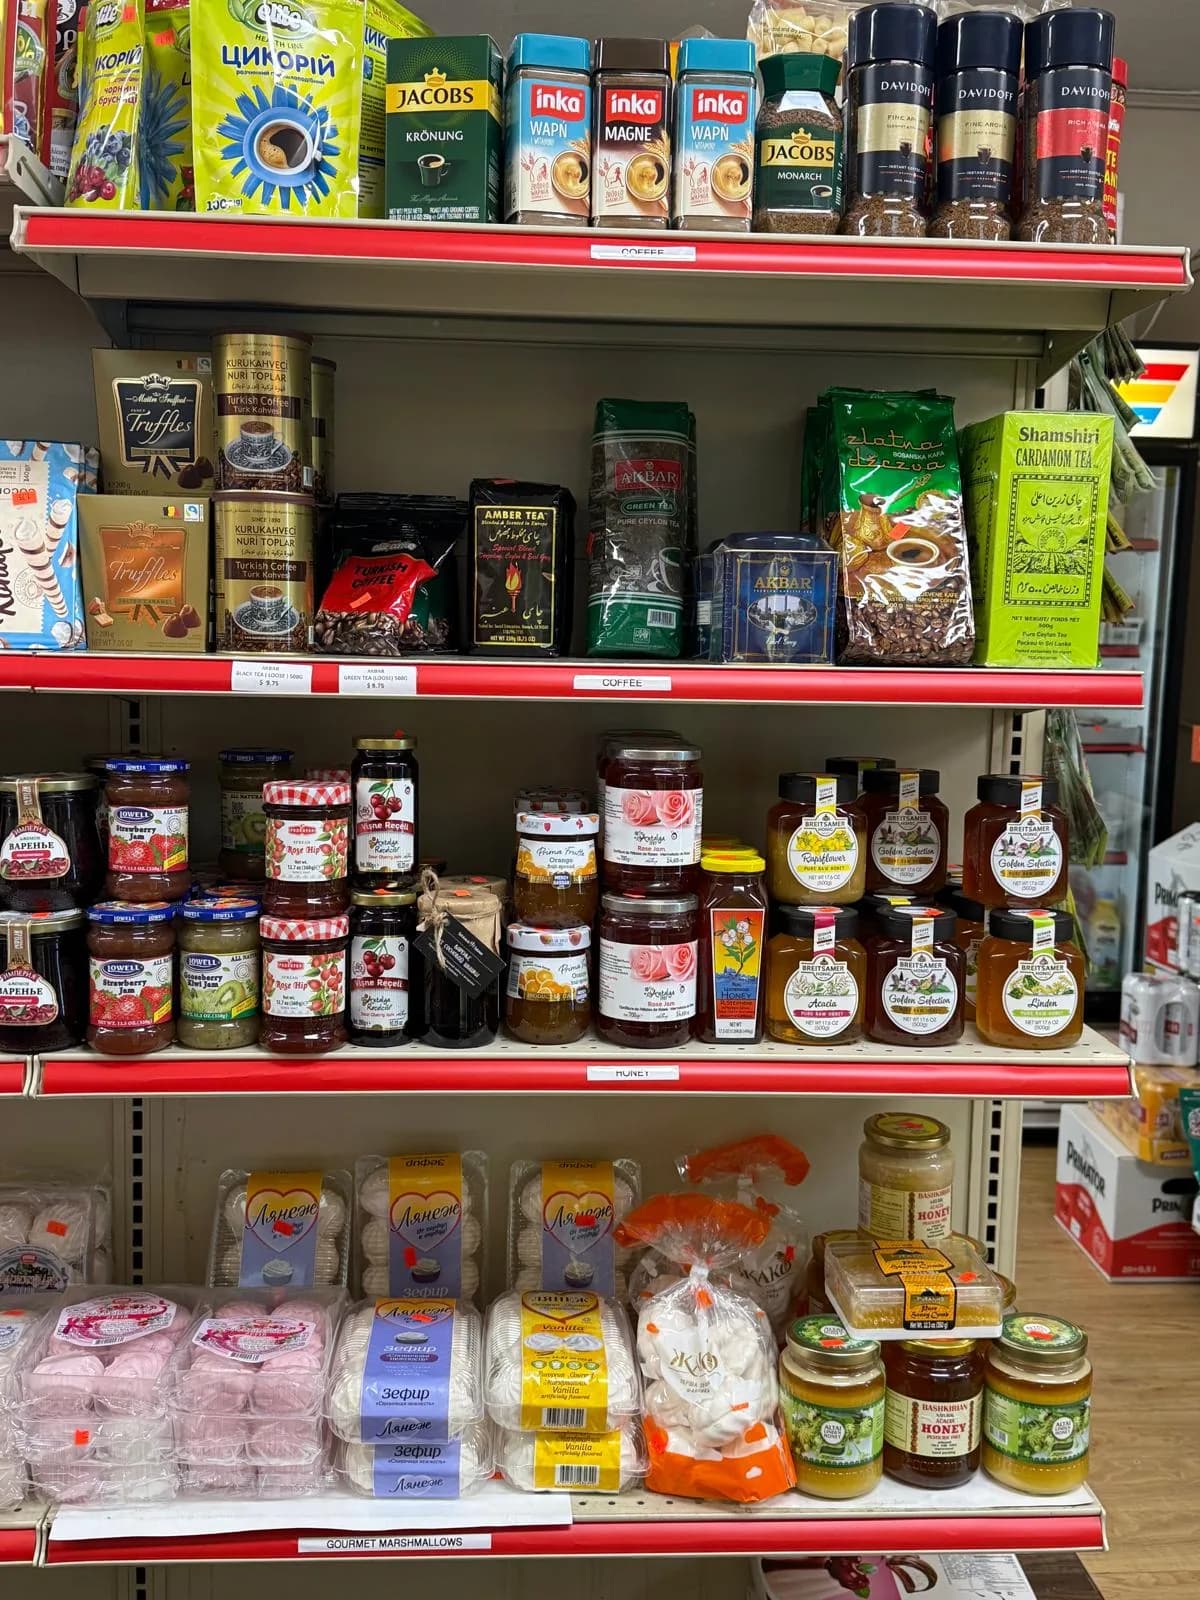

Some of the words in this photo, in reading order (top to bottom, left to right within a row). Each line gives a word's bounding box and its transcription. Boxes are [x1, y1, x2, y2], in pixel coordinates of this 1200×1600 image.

[221, 45, 335, 78] ЦИКОРІЙ
[881, 81, 931, 97] DAVIDOFF
[959, 88, 1014, 101] DAVIDOFF
[1061, 86, 1111, 100] DAVIDOFF
[396, 87, 474, 109] JACOBS
[536, 88, 580, 113] inka
[611, 93, 656, 115] inka
[698, 93, 742, 115] inka
[530, 120, 567, 138] WAPŃ
[691, 123, 729, 140] WAPŃ
[406, 129, 464, 142] KRÖNUNG
[767, 145, 834, 162] JACOBS
[777, 171, 821, 181] MONARCH
[621, 248, 664, 257] COFFEE
[227, 370, 248, 380] NURİ
[251, 371, 287, 382] TOPLAR
[227, 395, 258, 405] Turkish
[260, 396, 289, 407] Coffee
[126, 409, 192, 444] Truffles
[847, 427, 943, 450] zlatna
[1018, 426, 1100, 444] Shamshiri
[893, 451, 927, 460] BOSANSKA
[1015, 447, 1072, 468] CARDAMOM
[1075, 449, 1092, 468] TEA
[621, 470, 677, 484] AKBAR
[626, 502, 656, 510] GREEN
[485, 510, 521, 520] AMBER
[525, 511, 545, 520] TEA
[638, 518, 668, 526] CEYLON
[668, 520, 680, 528] TEA
[236, 537, 258, 546] NURİ
[260, 537, 295, 547] TOPLAR
[235, 561, 268, 571] Turkish
[270, 562, 297, 571] Coffee
[354, 562, 408, 577] TURKISH
[109, 557, 177, 593] Truffles
[351, 574, 397, 589] COFFEE
[754, 576, 812, 589] AKBAR
[602, 678, 643, 687] COFFEE
[119, 810, 150, 819] LOWELL
[116, 825, 157, 834] Strawberry
[384, 821, 409, 831] Reçeli
[9, 841, 55, 850] ВАРЕНЬЕ
[286, 845, 304, 855] Rose
[305, 845, 320, 855] Hip
[877, 846, 904, 856] Golden
[905, 846, 935, 856] Selection
[801, 852, 846, 865] Rapsflower
[998, 858, 1026, 869] Golden
[1026, 858, 1057, 869] Selection
[188, 957, 217, 966] LOWELL
[107, 964, 141, 973] LOWELL
[183, 971, 223, 982] Gooseberry
[102, 979, 147, 987] Strawberry
[202, 981, 219, 989] Jam
[276, 981, 292, 991] Rose
[293, 981, 308, 991] Hip
[376, 979, 403, 989] Reçeli
[118, 987, 135, 995] Jam
[721, 990, 753, 1000] HONEY
[807, 997, 838, 1009] Acacia
[888, 994, 916, 1005] Golden
[917, 995, 951, 1006] Selection
[1027, 997, 1059, 1009] Linden
[1066, 1139, 1106, 1199] PRIMATOR
[245, 1202, 319, 1230] Лянеж
[390, 1203, 459, 1232] Лянеж
[918, 1206, 950, 1221] HONEY
[402, 1287, 449, 1298] Зефир
[922, 1305, 938, 1313] Pure
[384, 1345, 437, 1353] Зефир
[381, 1388, 430, 1401] Зефир
[552, 1386, 580, 1394] Vanilla
[922, 1403, 968, 1412] BASHKIRIAN
[375, 1421, 433, 1437] Лянеж
[921, 1423, 966, 1434] HONEY
[393, 1445, 442, 1459] Зефир
[565, 1443, 593, 1451] Vanilla
[389, 1478, 444, 1493] Лянеж
[326, 1538, 377, 1549] GOURMET
[379, 1537, 463, 1548] MARSHMALLOWS
